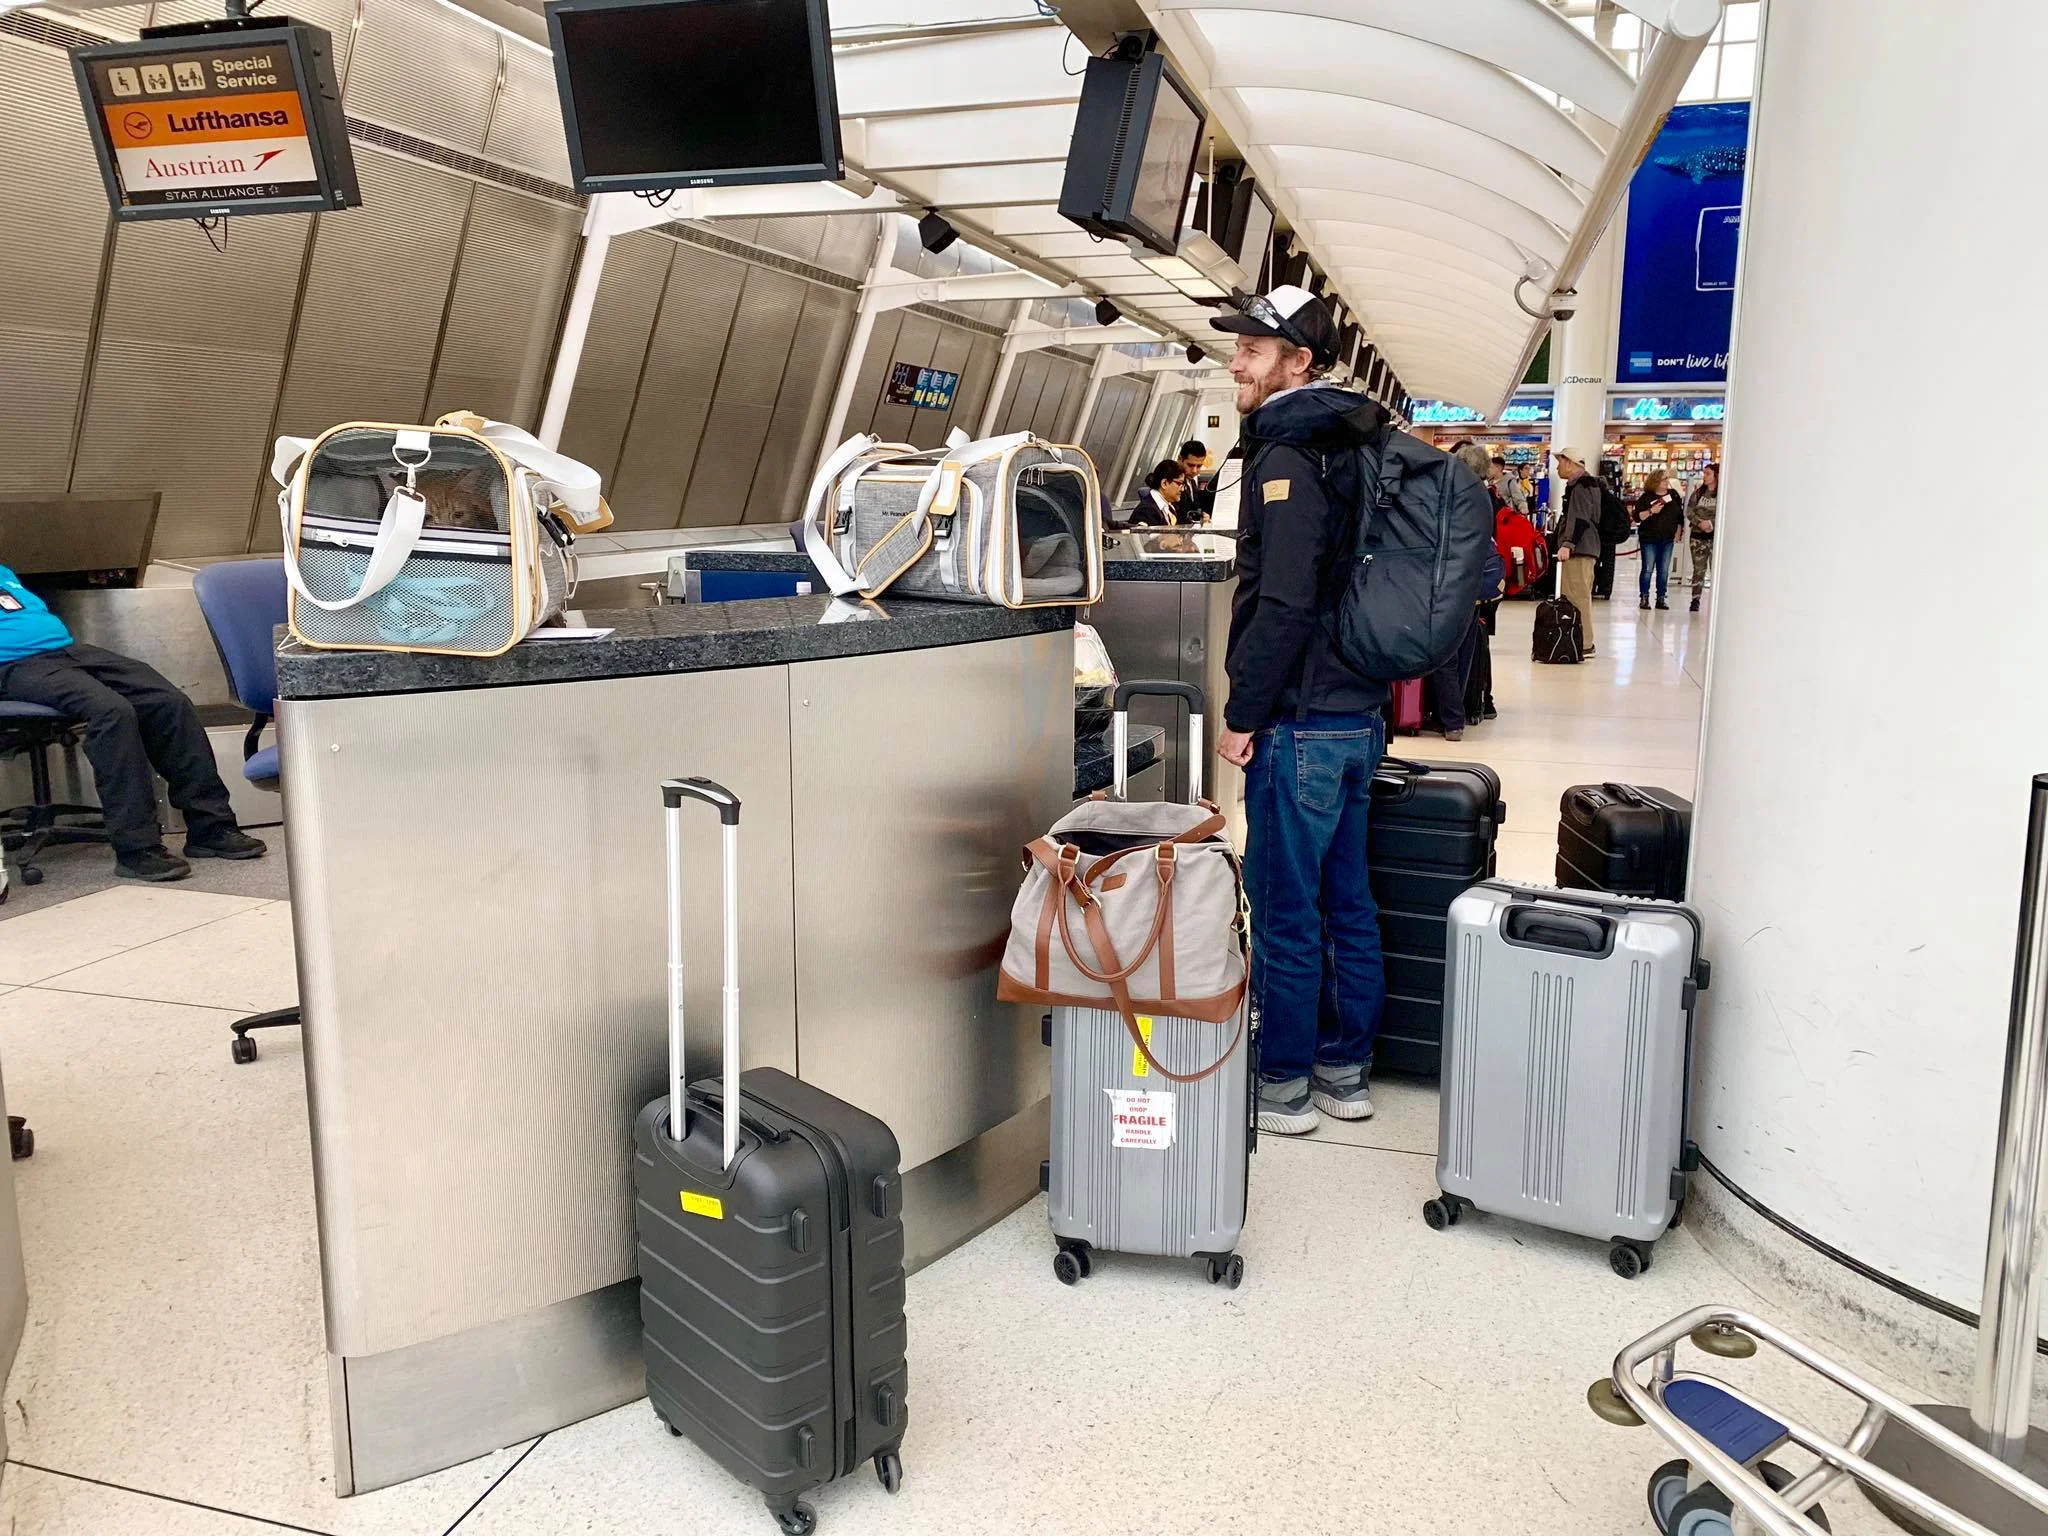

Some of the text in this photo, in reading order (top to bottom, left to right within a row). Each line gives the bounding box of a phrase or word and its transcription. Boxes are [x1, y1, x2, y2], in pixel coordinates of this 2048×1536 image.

[212, 55, 273, 75] Special
[216, 73, 278, 89] Service
[167, 109, 289, 133] Lufthansa
[145, 155, 246, 178] Austrian
[165, 186, 265, 201] STAR ALLIANCE
[1657, 358, 1685, 366] DON'T
[1686, 353, 1712, 369] live
[1713, 352, 1730, 370] lif
[1113, 1114, 1167, 1127] FRAGILE
[1125, 1128, 1152, 1136] HANDLE
[1120, 1137, 1157, 1145] CAREFULLY
